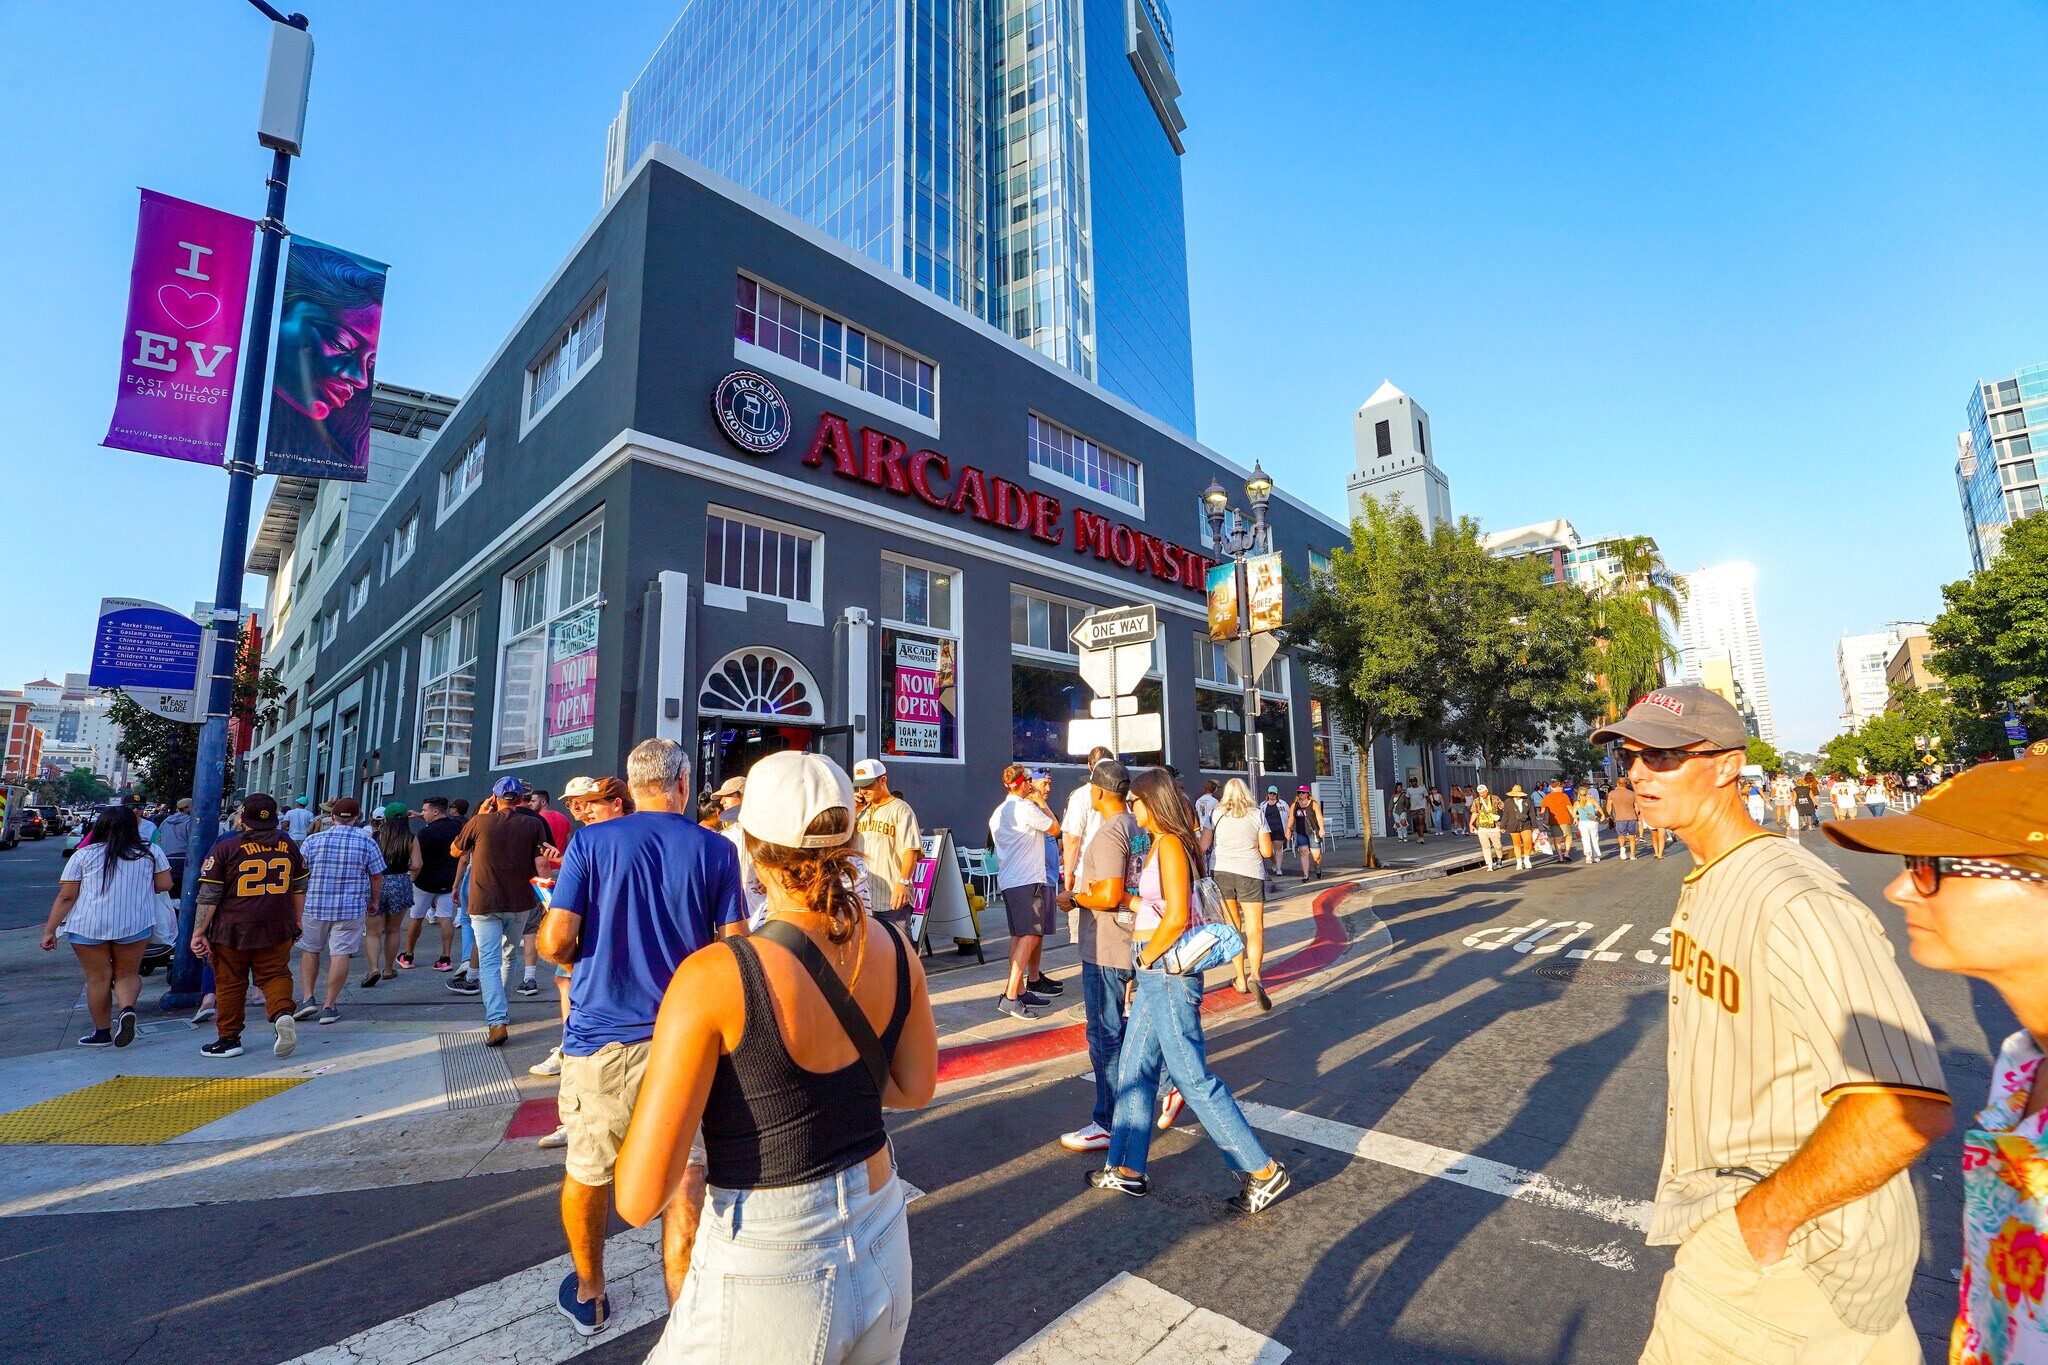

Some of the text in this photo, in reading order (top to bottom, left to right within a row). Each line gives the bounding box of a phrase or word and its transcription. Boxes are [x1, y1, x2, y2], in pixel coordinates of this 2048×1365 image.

[175, 241, 213, 281] I
[132, 330, 233, 378] EV
[127, 374, 229, 397] EAST VILLAGE
[136, 386, 218, 405] SAN DIEGO
[732, 379, 780, 409] ARCADE
[114, 426, 222, 448] EastVillageSanDiego.com
[724, 409, 781, 446] MONSTERS
[268, 451, 365, 470] EastVillageSanDiego.com
[802, 411, 1064, 546] ARCADE
[105, 599, 142, 608] DOWNTOWN
[120, 629, 147, 637] Gaslamp
[559, 615, 596, 651] ARCADE
[1092, 617, 1146, 639] ONE WAY
[116, 652, 148, 660] Children's
[899, 644, 939, 660] ARCADE
[115, 660, 147, 669] Children's
[561, 656, 588, 693] NOW
[900, 673, 937, 695] NOW
[160, 705, 187, 713] VILLAGE
[557, 693, 590, 730] OPEN
[897, 695, 939, 717] OPEN
[1649, 693, 1684, 716] CLARA
[898, 726, 917, 737] 10AM
[924, 728, 938, 738] 2AM
[900, 737, 937, 749] EVERY DAY
[870, 820, 896, 837] DIEGO
[275, 841, 289, 854] JR.
[237, 857, 292, 897] 23
[1670, 928, 1741, 1015] DEGO
